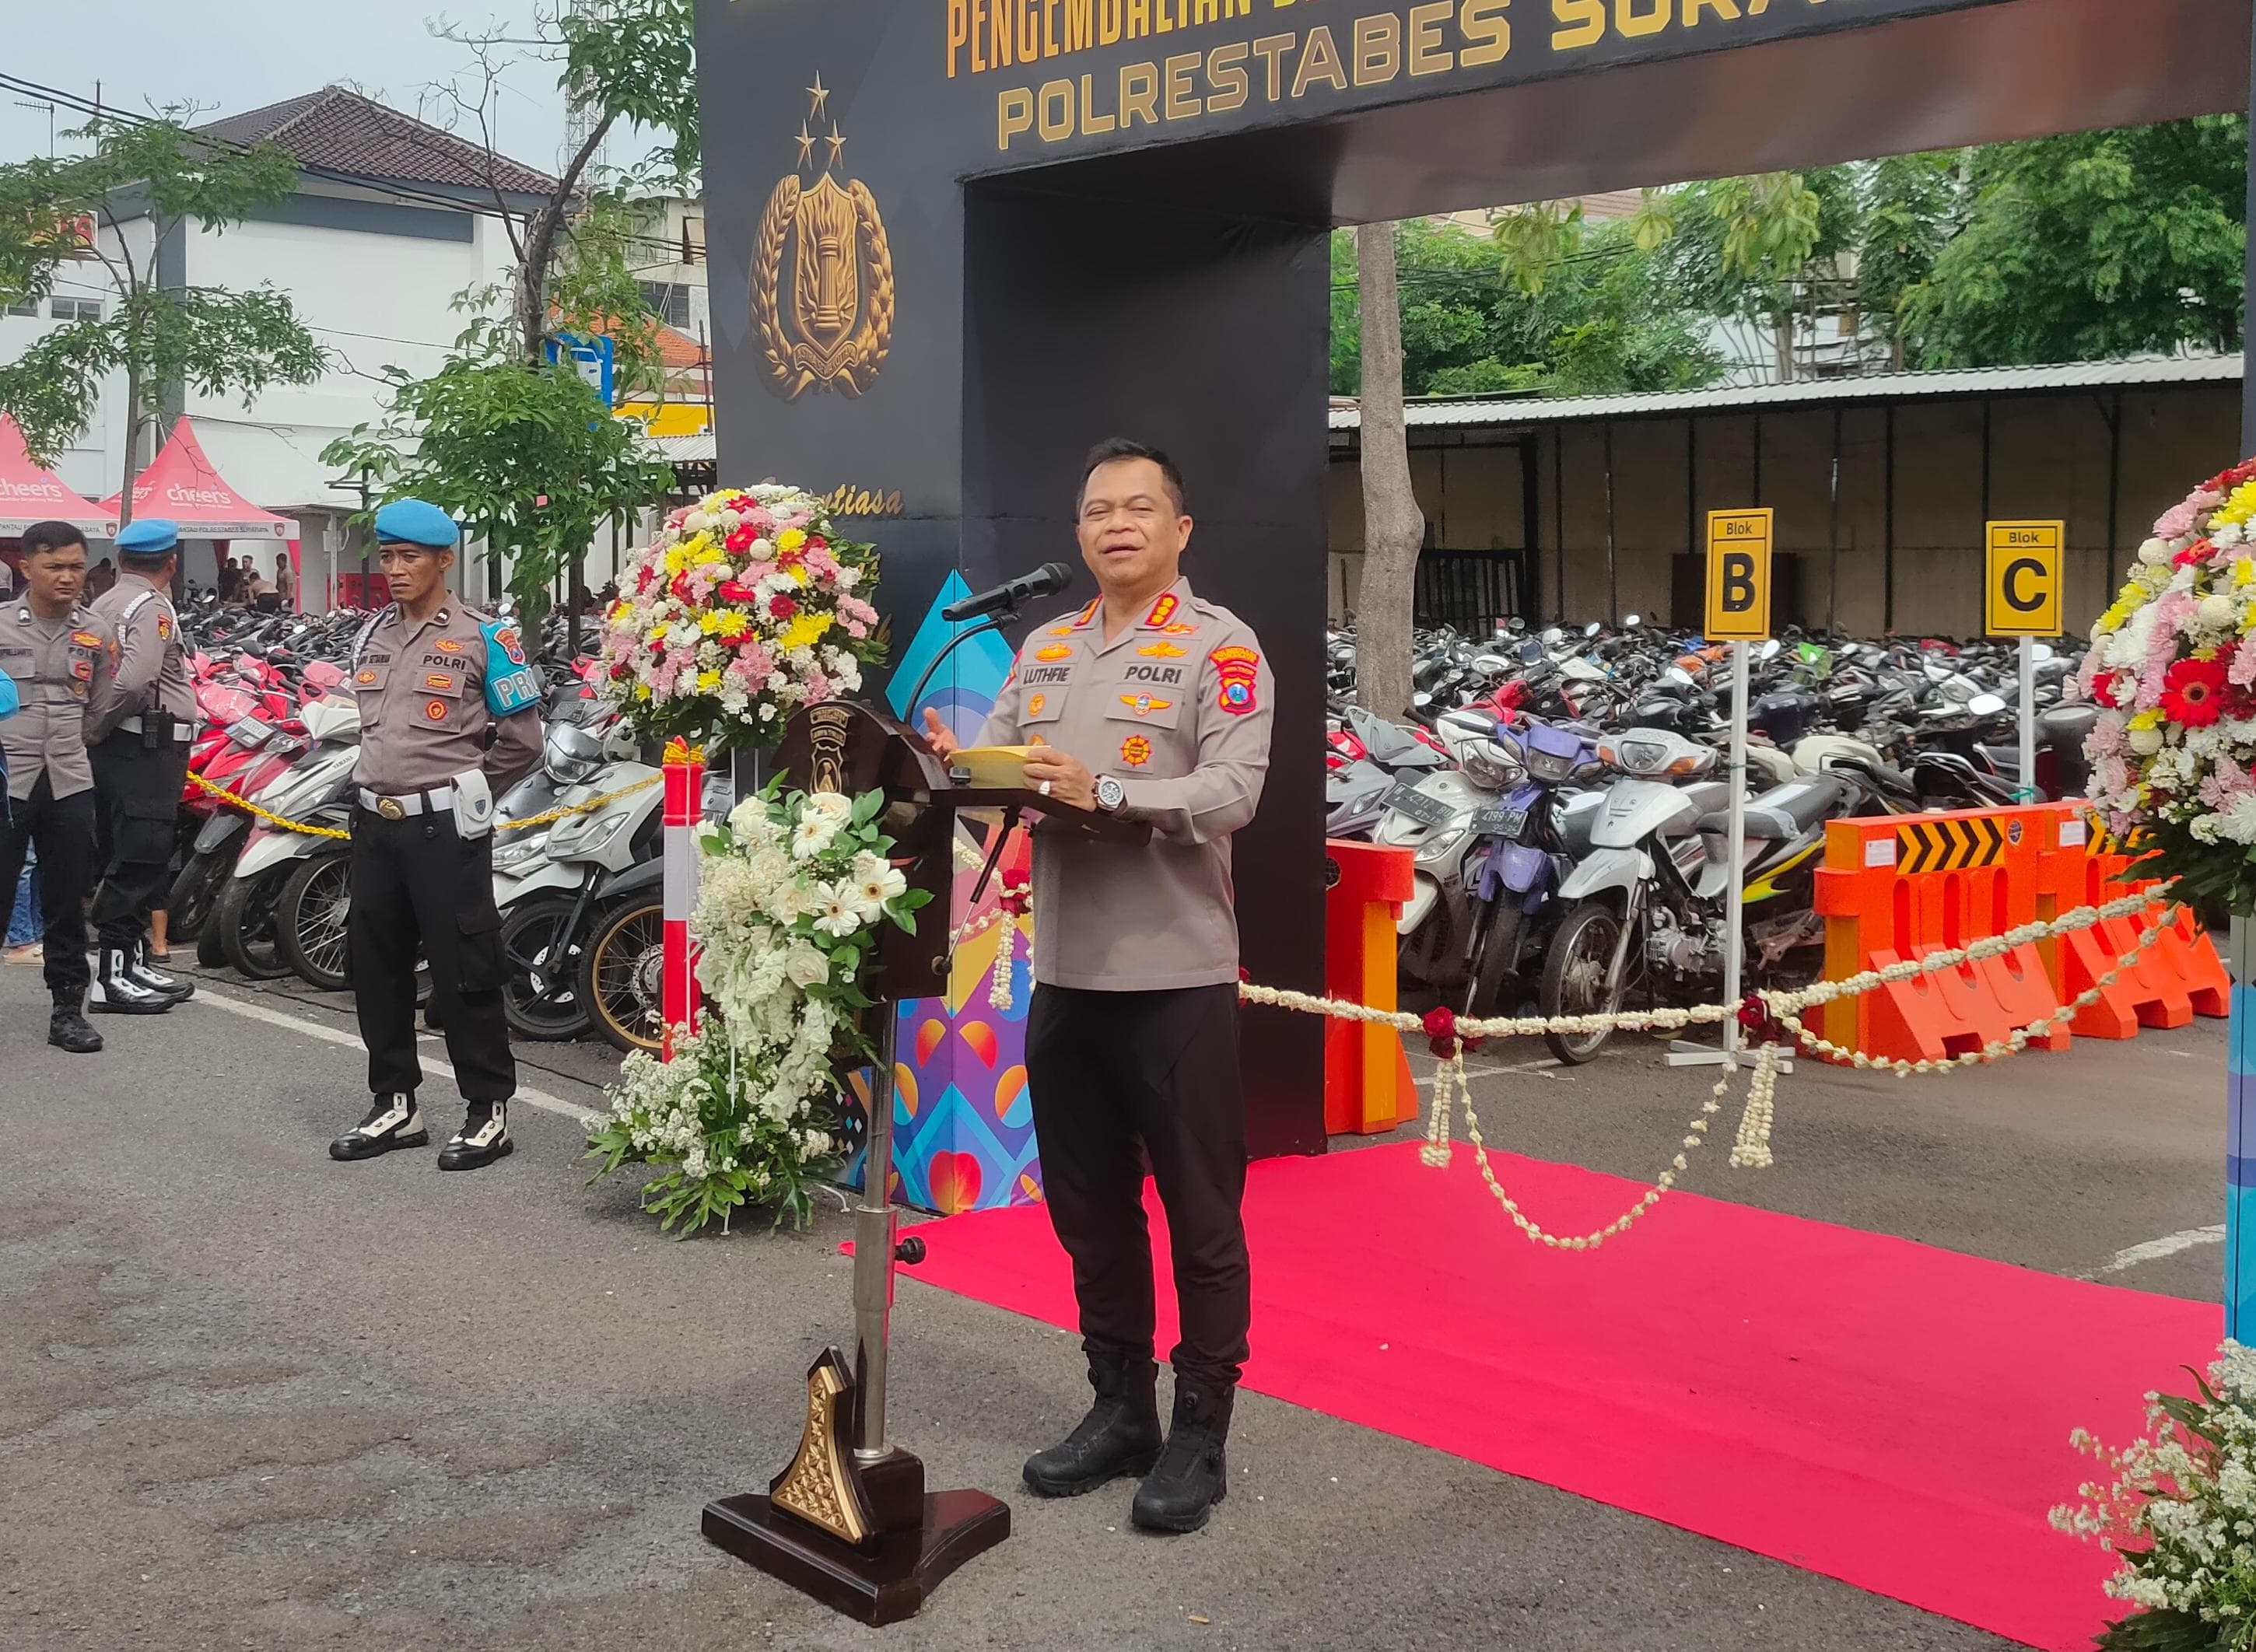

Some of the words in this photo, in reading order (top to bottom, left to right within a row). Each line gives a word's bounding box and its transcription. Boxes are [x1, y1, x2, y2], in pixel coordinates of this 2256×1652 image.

[997, 0, 1511, 150] POLRESTABES
[166, 483, 232, 505] cheers
[1726, 522, 1753, 535] Blok
[2009, 532, 2040, 544] Blok
[1722, 552, 1756, 612] B
[2002, 558, 2048, 612] C
[423, 655, 467, 670] POLRI
[1023, 667, 1070, 685] LUTHFIE
[1123, 665, 1182, 684] POLRI
